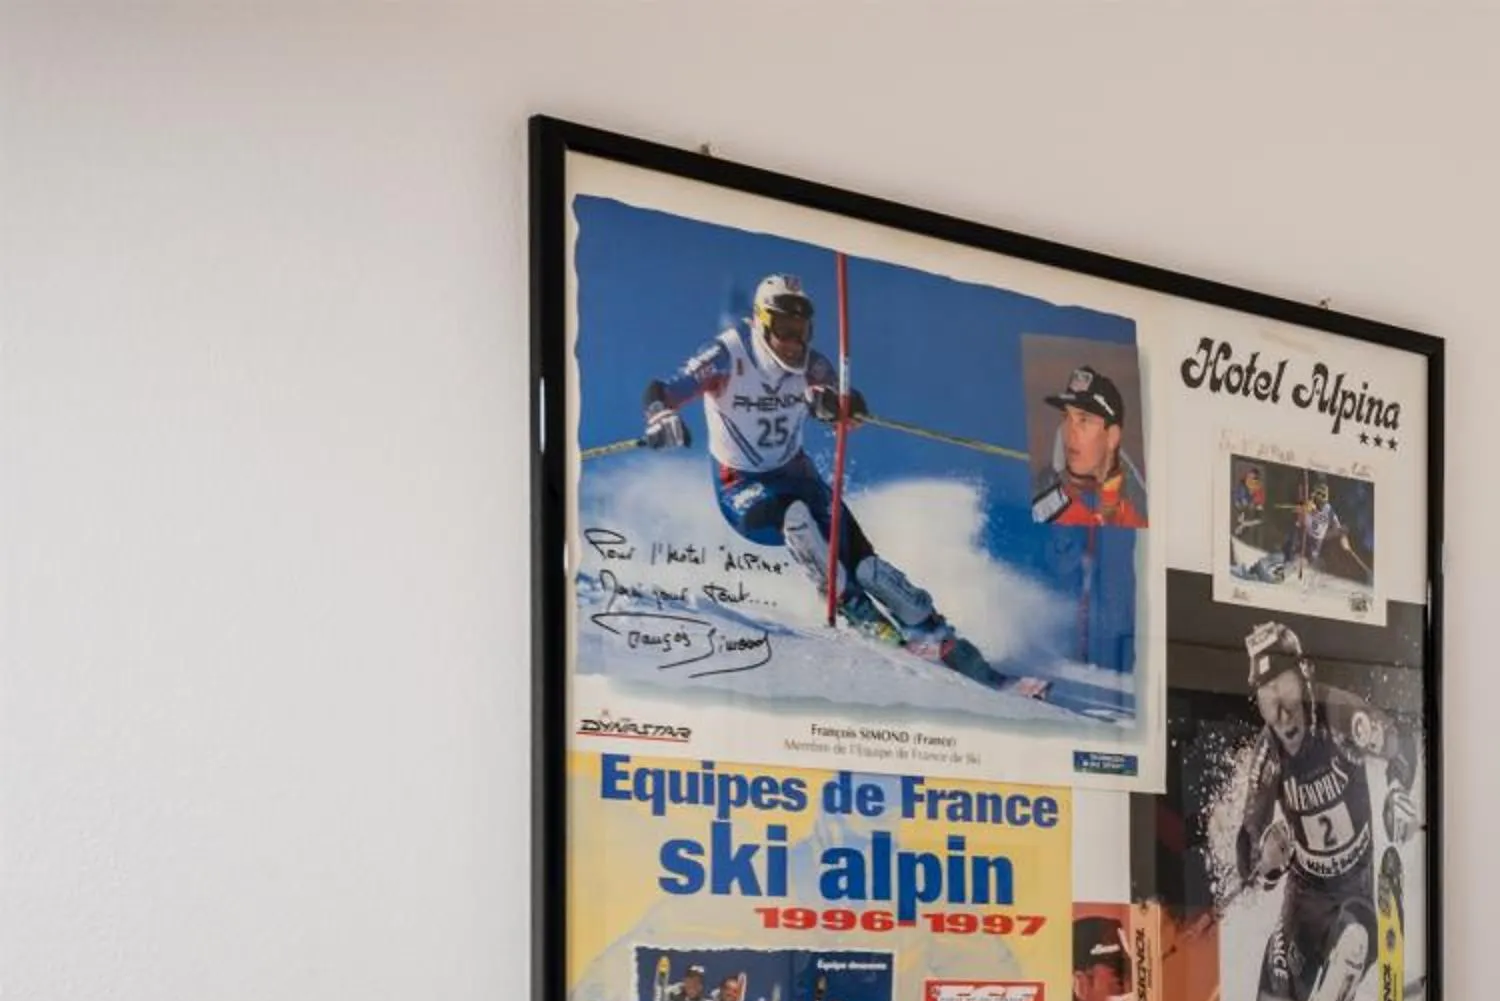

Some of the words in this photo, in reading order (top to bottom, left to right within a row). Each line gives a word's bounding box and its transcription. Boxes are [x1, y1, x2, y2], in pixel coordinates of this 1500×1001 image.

[1180, 336, 1288, 404] Hotel
[1291, 362, 1400, 435] Alpina
[757, 416, 789, 448] 25
[579, 718, 693, 738] DYNASTAR
[811, 723, 857, 741] François
[860, 726, 909, 742] SIMOND
[601, 753, 808, 820] Equipes
[822, 771, 884, 815] de
[901, 776, 1059, 828] France
[1318, 815, 1337, 848] 2
[658, 820, 787, 897] ski
[819, 831, 1015, 921] alpin
[754, 907, 1046, 936] 1996-1997
